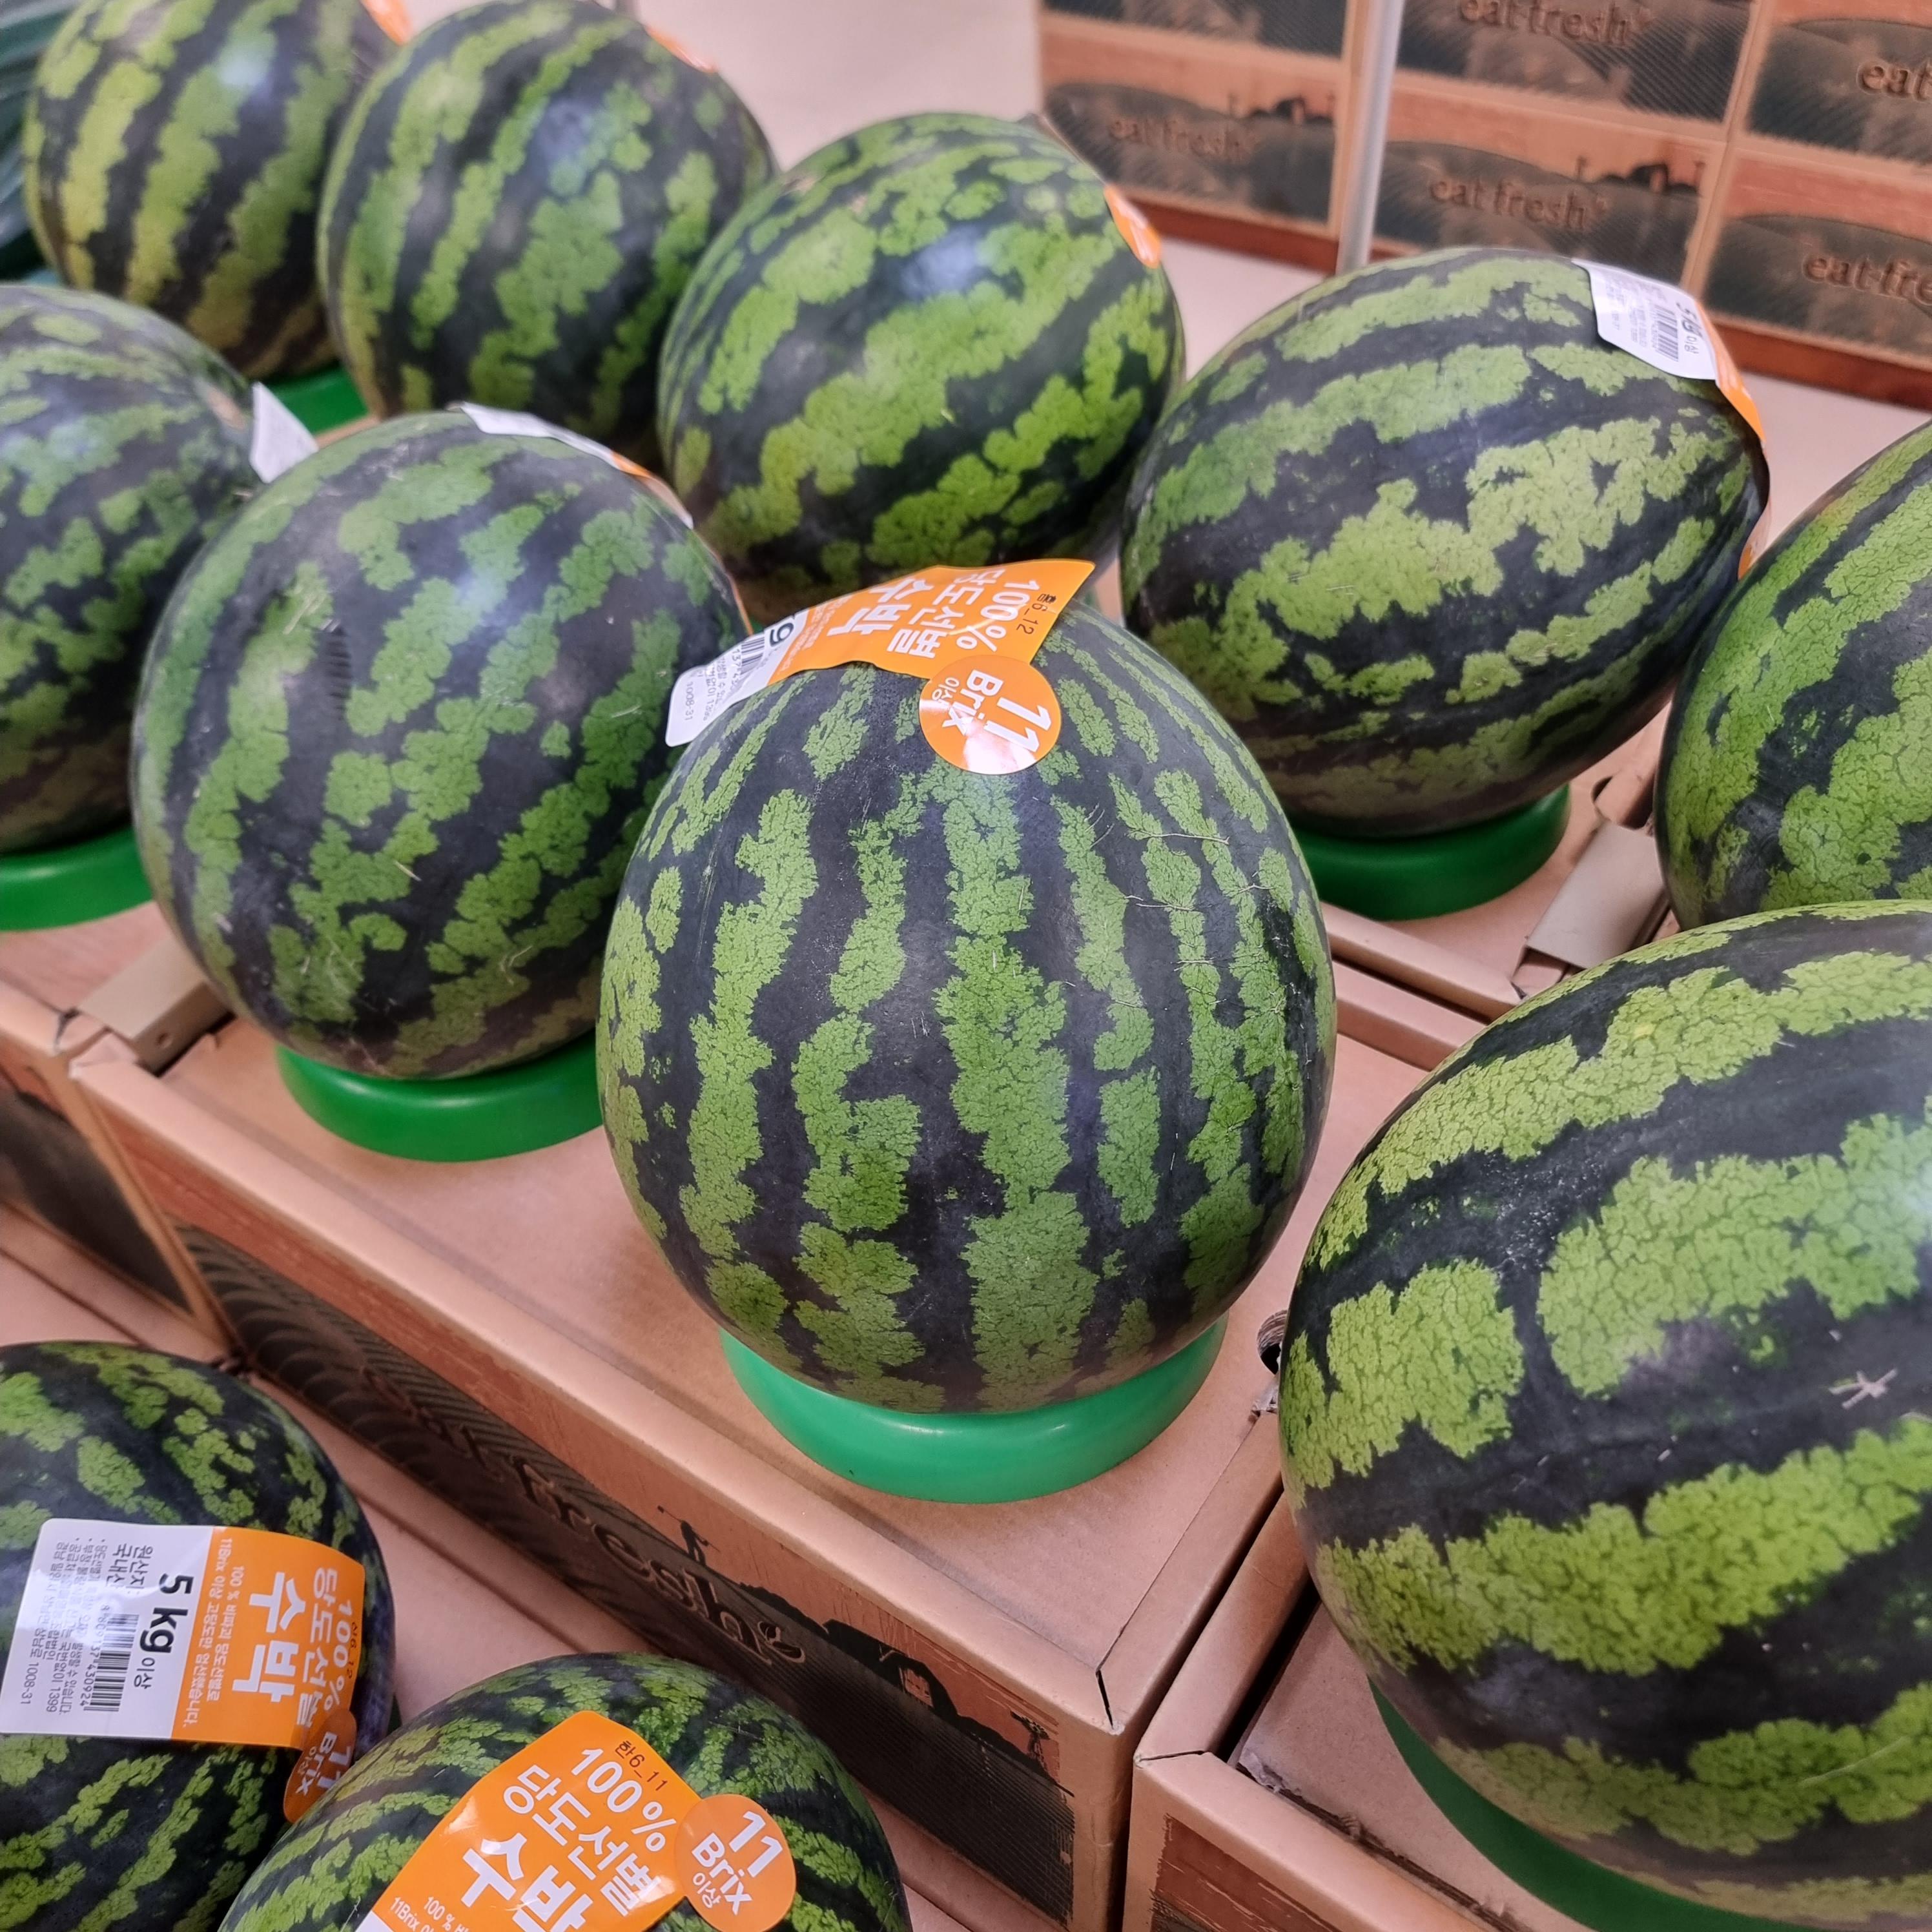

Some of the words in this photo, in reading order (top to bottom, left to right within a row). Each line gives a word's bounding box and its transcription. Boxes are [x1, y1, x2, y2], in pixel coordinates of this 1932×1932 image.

[1429, 178, 1484, 210] eat
[1493, 178, 1588, 231] fresh
[1803, 254, 1873, 291] eat
[827, 577, 934, 637] 수박
[886, 568, 1006, 659] 당도선별
[941, 669, 1004, 736] Brix
[996, 697, 1052, 753] 11
[159, 1574, 194, 1594] 5
[512, 1455, 772, 1666] fresh
[210, 1576, 225, 1599] 이상
[30, 1629, 46, 1658] 상남로
[140, 1608, 189, 1654] kg
[199, 1601, 220, 1649] 고당도만
[232, 1572, 307, 1703] 수박
[297, 1568, 338, 1727] 당도선별
[21, 1663, 38, 1705] 1008-31
[52, 1642, 71, 1683] 국번없이
[80, 1665, 97, 1706] 430924
[134, 1658, 156, 1689] 이상
[47, 1687, 60, 1712] 1399
[295, 1731, 338, 1796] Brix
[503, 1764, 662, 1917] 당도선별
[728, 1811, 783, 1878] 11
[460, 1832, 593, 1932] 수박
[692, 1833, 753, 1916] Brix
[692, 1873, 721, 1909] 이상
[389, 1896, 420, 1932] 11Brix
